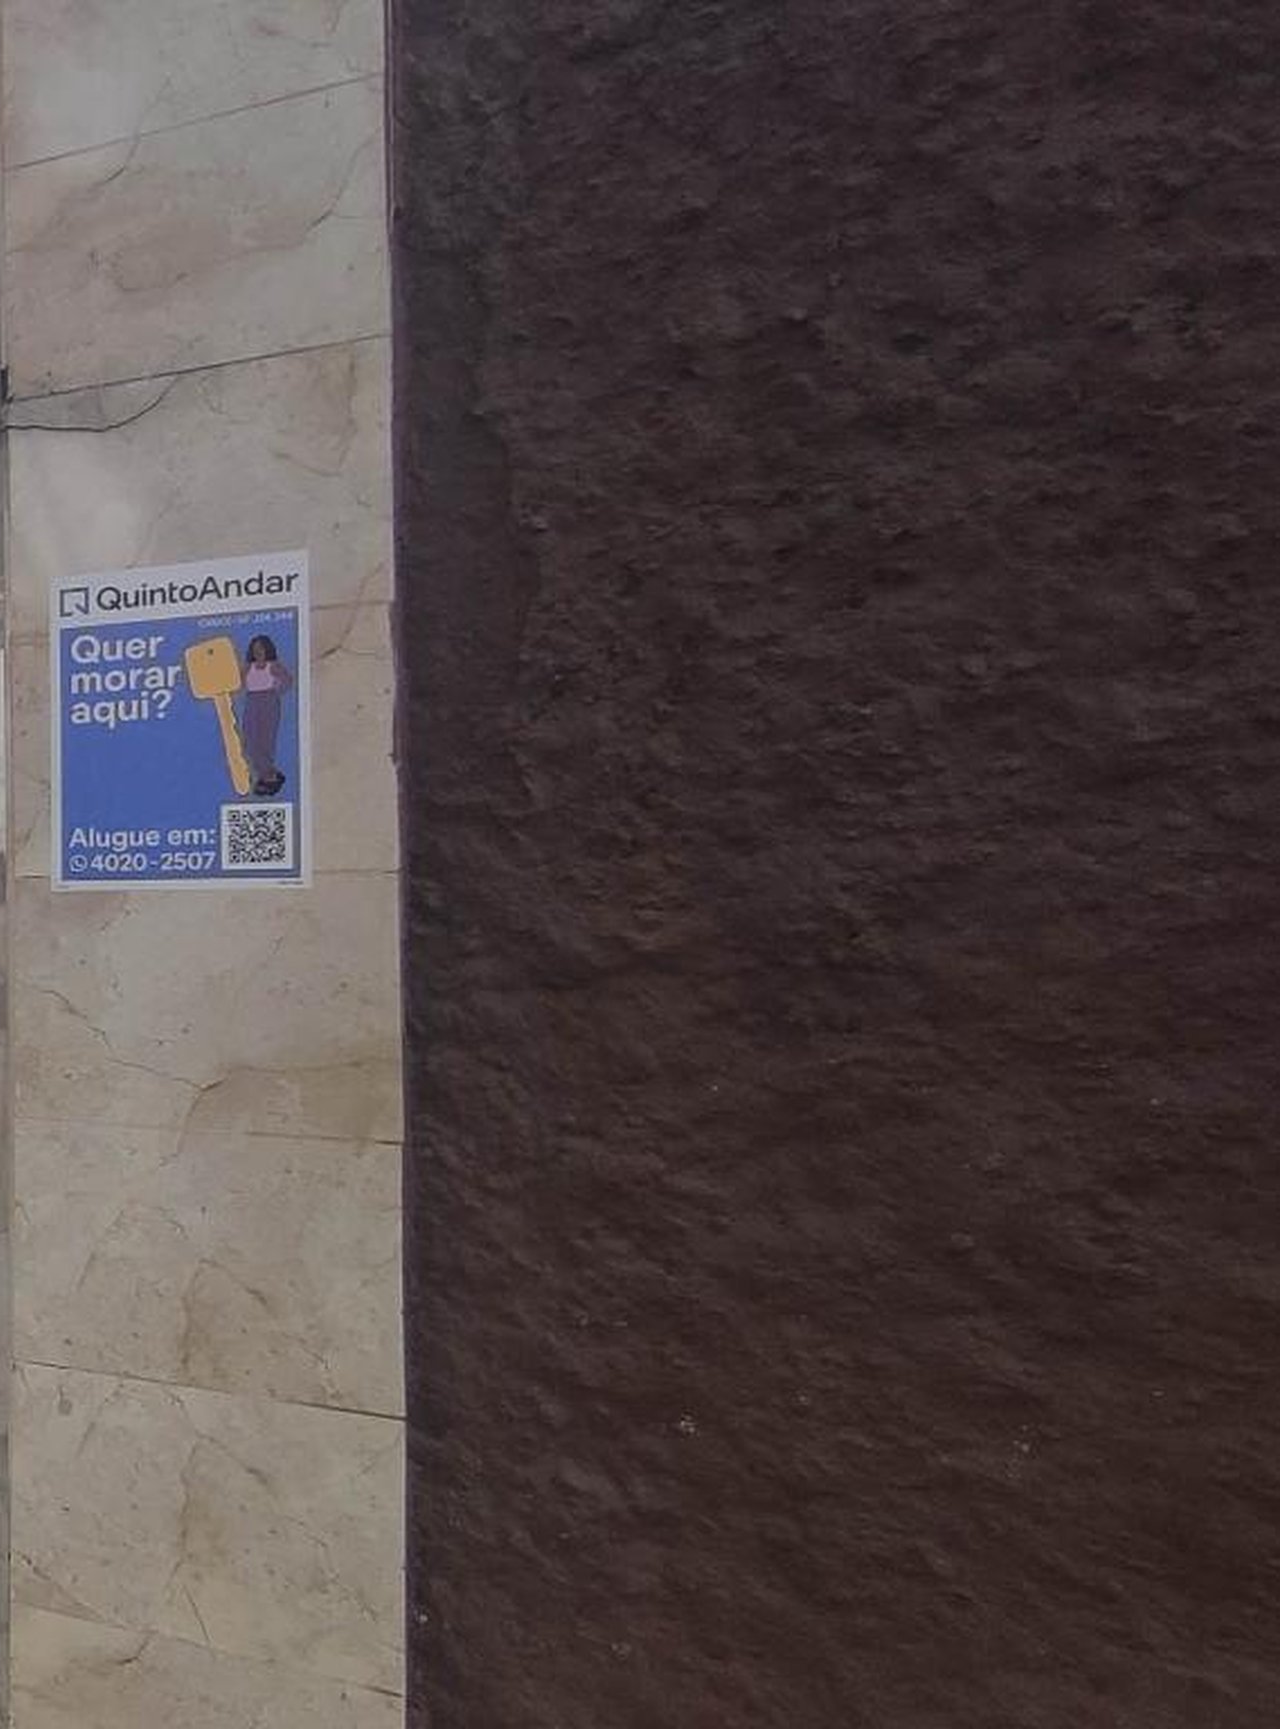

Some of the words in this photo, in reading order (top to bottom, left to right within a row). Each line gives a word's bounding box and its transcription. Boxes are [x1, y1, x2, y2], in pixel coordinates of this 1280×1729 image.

[96, 571, 299, 611] QuintoAndar
[71, 635, 164, 663] Quer
[70, 665, 181, 694] morar
[71, 690, 172, 729] aqui?
[69, 828, 161, 852] Alugue
[167, 828, 216, 845] em:
